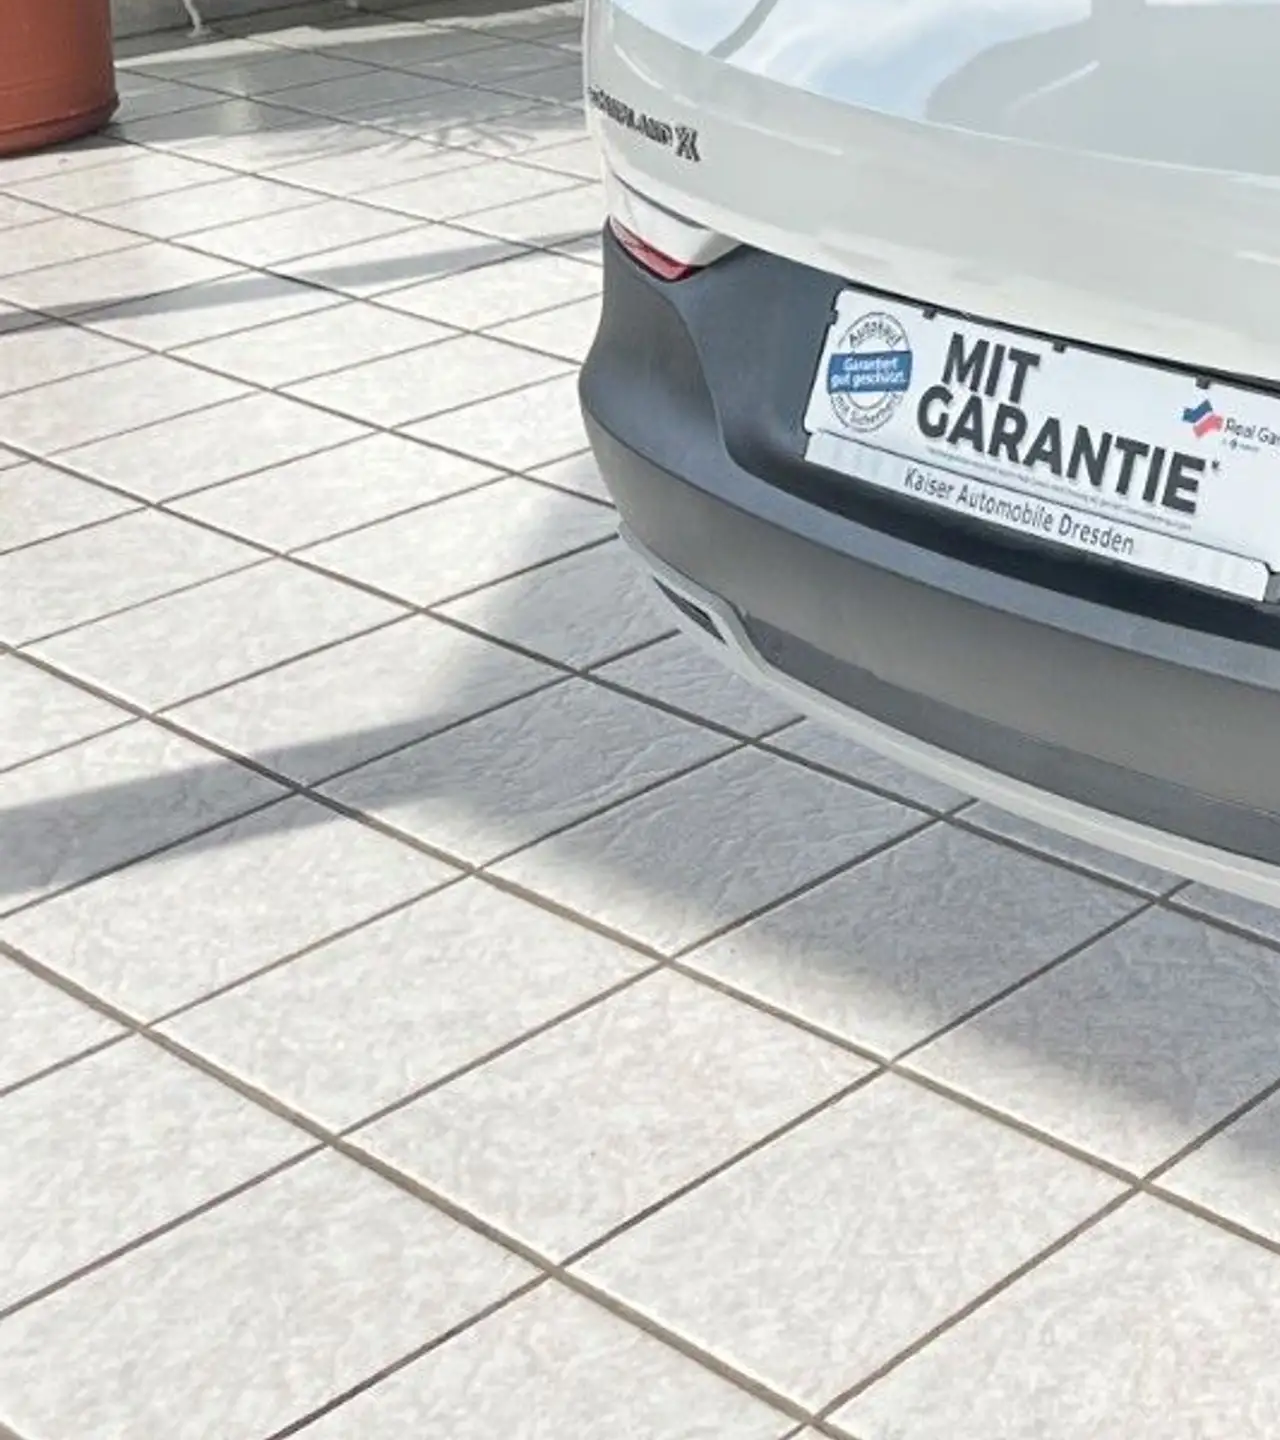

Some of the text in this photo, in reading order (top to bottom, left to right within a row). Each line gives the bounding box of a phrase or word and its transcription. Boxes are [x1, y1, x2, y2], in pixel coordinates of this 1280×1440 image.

[941, 332, 1041, 404] MIT
[1224, 416, 1256, 440] Real
[903, 466, 955, 499] Kaiser
[955, 480, 1053, 534] Automobile
[1057, 511, 1135, 557] Dresden
